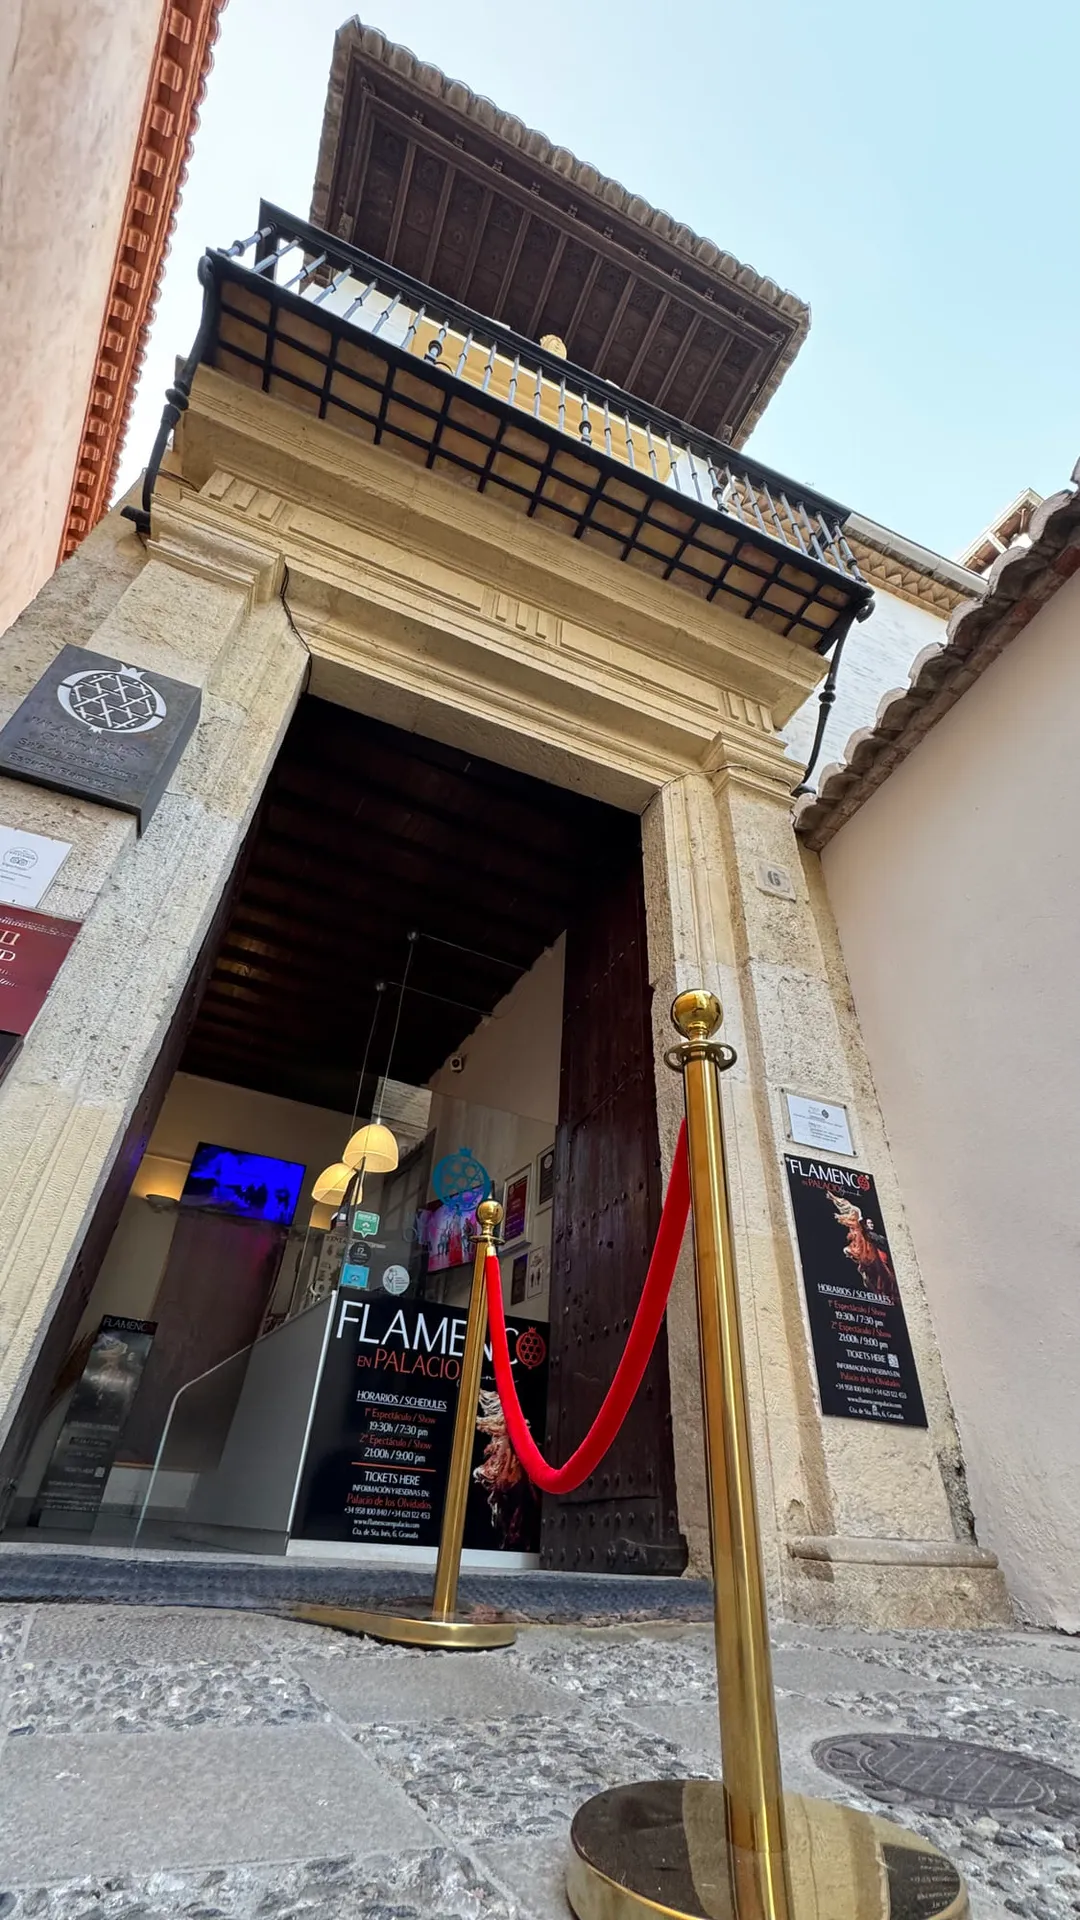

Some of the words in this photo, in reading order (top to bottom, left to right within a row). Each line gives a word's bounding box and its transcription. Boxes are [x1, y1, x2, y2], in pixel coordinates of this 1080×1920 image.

[817, 1283, 852, 1297] HORARIOS
[357, 1355, 372, 1368] EN
[374, 1348, 460, 1380] PALACIO
[357, 1390, 399, 1404] HORARIOS
[404, 1396, 447, 1410] SCHEDULES
[418, 1413, 436, 1424] Show
[369, 1421, 393, 1433] 19:30h
[400, 1424, 416, 1435] 7:30
[417, 1428, 428, 1438] pm
[413, 1439, 432, 1449] Show
[364, 1447, 389, 1459] 21:00h
[395, 1450, 413, 1461] 9:00
[414, 1454, 426, 1464] pm
[364, 1470, 398, 1483] TICKETS
[399, 1474, 420, 1485] HERE
[346, 1492, 373, 1504] Palacio
[374, 1496, 383, 1506] de
[385, 1496, 395, 1507] los
[397, 1497, 432, 1510] Olvidados
